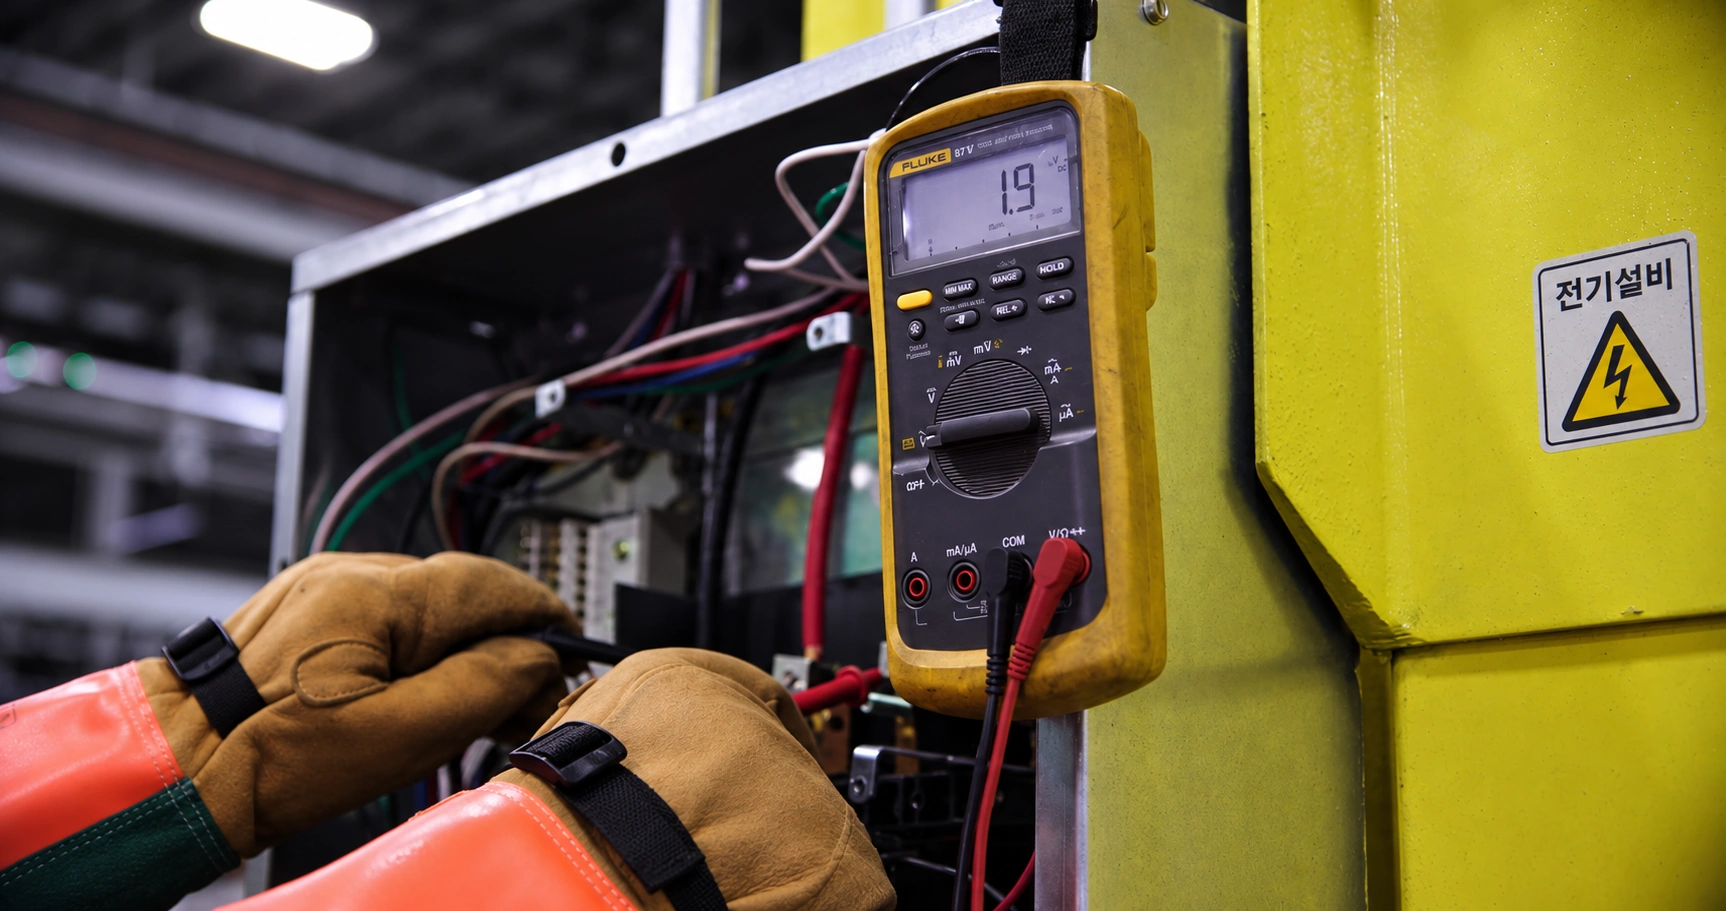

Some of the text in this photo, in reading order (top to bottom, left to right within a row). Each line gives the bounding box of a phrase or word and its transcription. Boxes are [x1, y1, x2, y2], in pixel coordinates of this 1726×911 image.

[902, 152, 947, 172] FLUKE
[1001, 163, 1036, 216] 1.9
[1039, 262, 1065, 275] HOLD
[992, 272, 1018, 285] RANGE
[1556, 258, 1673, 312] 전기설비
[1002, 535, 1026, 548] COM
[910, 552, 918, 563] A
